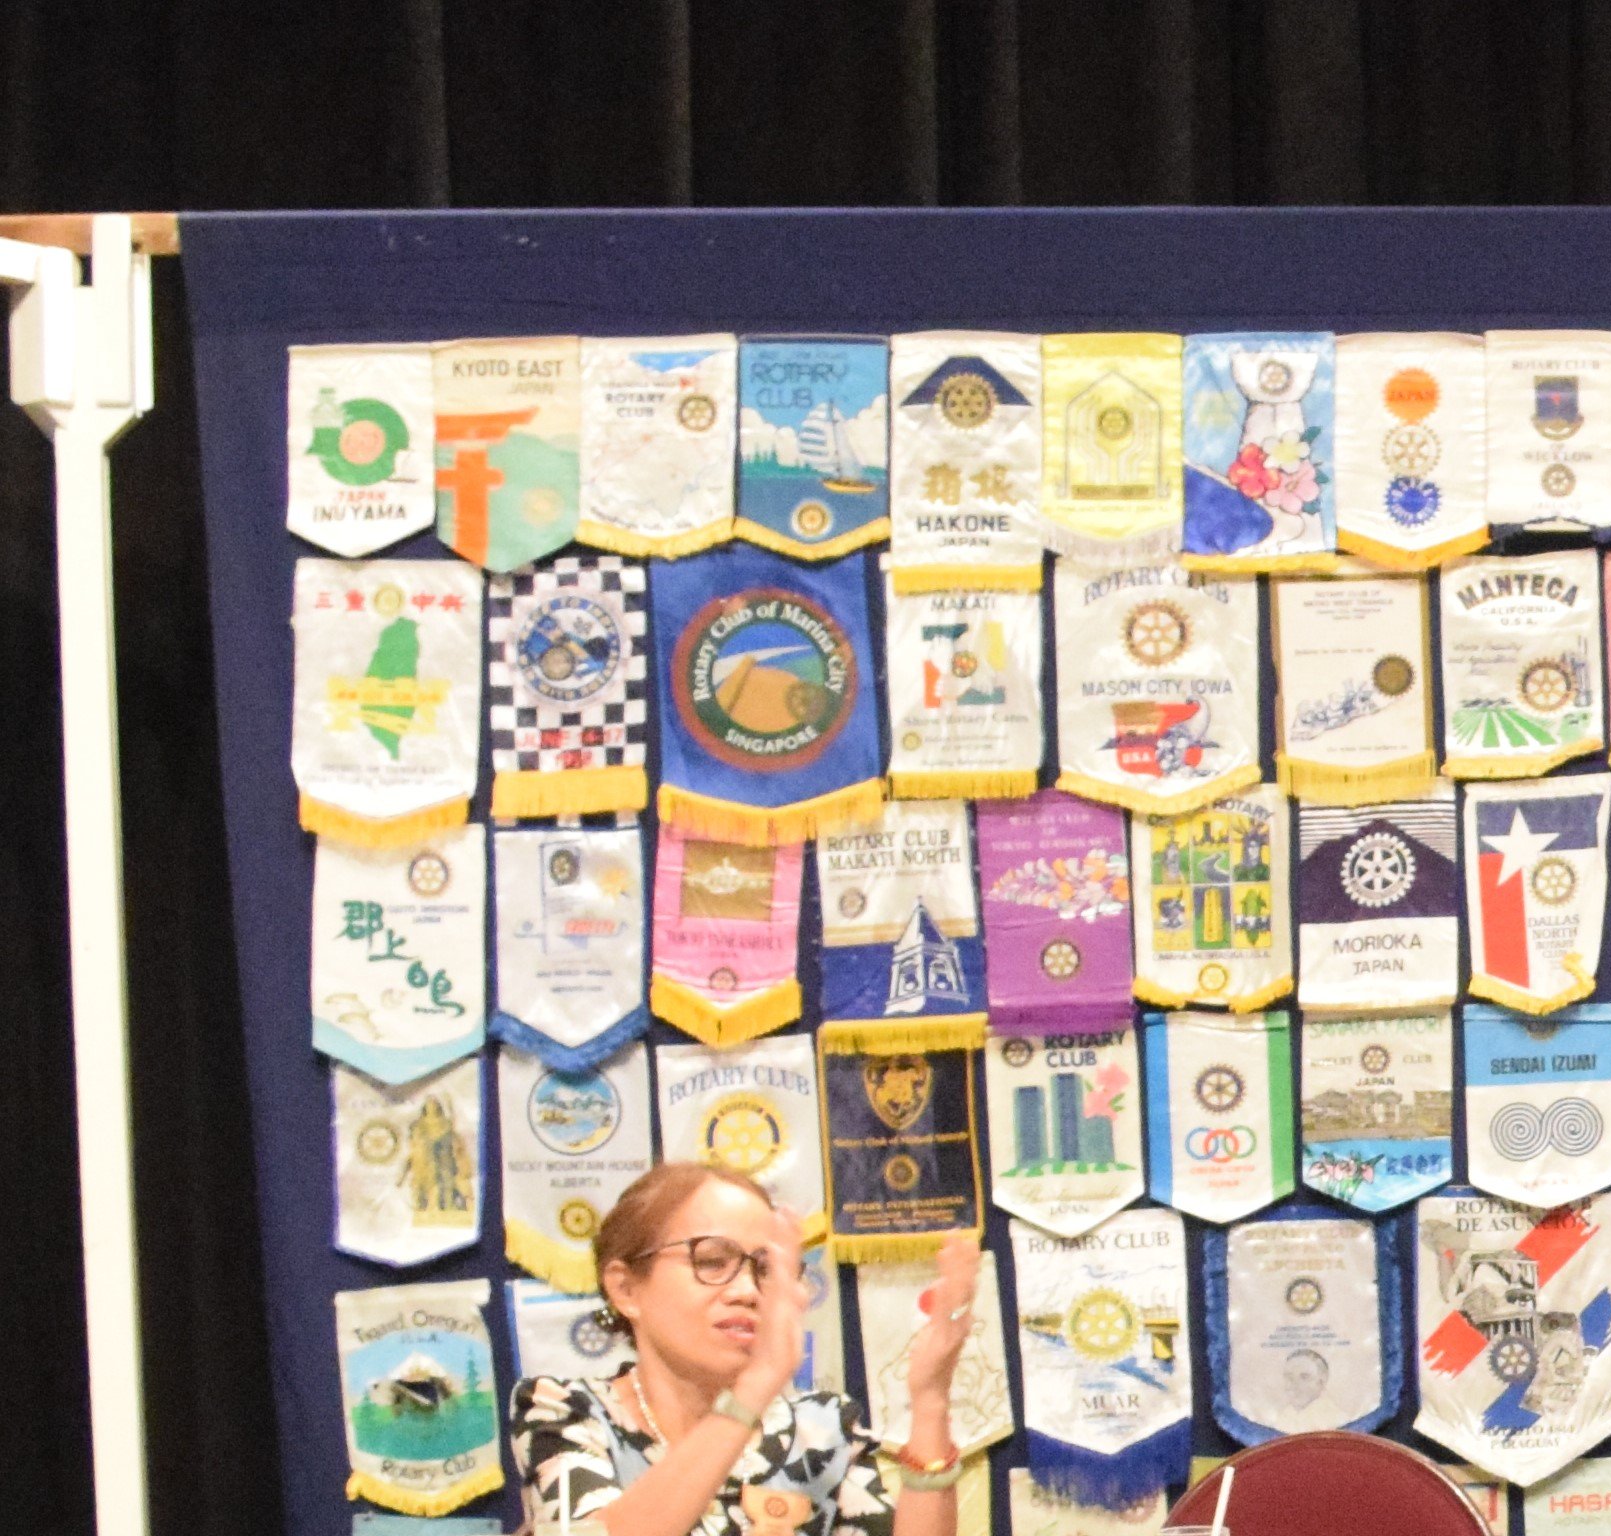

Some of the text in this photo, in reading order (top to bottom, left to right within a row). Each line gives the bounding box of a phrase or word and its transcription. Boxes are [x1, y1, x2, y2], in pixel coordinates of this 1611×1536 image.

[1511, 361, 1562, 370] ROTARY
[916, 514, 1012, 533] HAKONE
[938, 536, 989, 548] JAPAN
[1084, 567, 1164, 605] ROTARY
[1456, 574, 1580, 610] MANTECA
[1480, 607, 1557, 616] CALIFORNIA
[693, 601, 847, 701] Rotary Club of Marina City
[1082, 679, 1233, 696] MASON IOWA
[725, 724, 819, 753] SINGAPORE
[827, 830, 951, 850] ROTARY CLUB
[827, 848, 962, 870] MAKATI NORTH
[1528, 914, 1580, 927] DALLAS
[1532, 927, 1578, 939] NORTH
[1333, 935, 1423, 956] MORIOKA
[1352, 958, 1405, 975] JAPAN
[1043, 1031, 1126, 1050] ROTARY
[1046, 1052, 1097, 1067] CLUB
[1403, 1054, 1432, 1064] CLUB
[1490, 1054, 1596, 1075] SENDAI IZUMI
[668, 1066, 810, 1104] ROTARY CLUB
[1355, 1077, 1395, 1086] JAPAN
[1456, 1217, 1485, 1233] DE
[1028, 1230, 1170, 1254] ROTARY CLUB
[412, 1310, 477, 1333] Oregon
[1082, 1393, 1140, 1411] MUAR
[381, 1456, 475, 1479] Rotary Club
